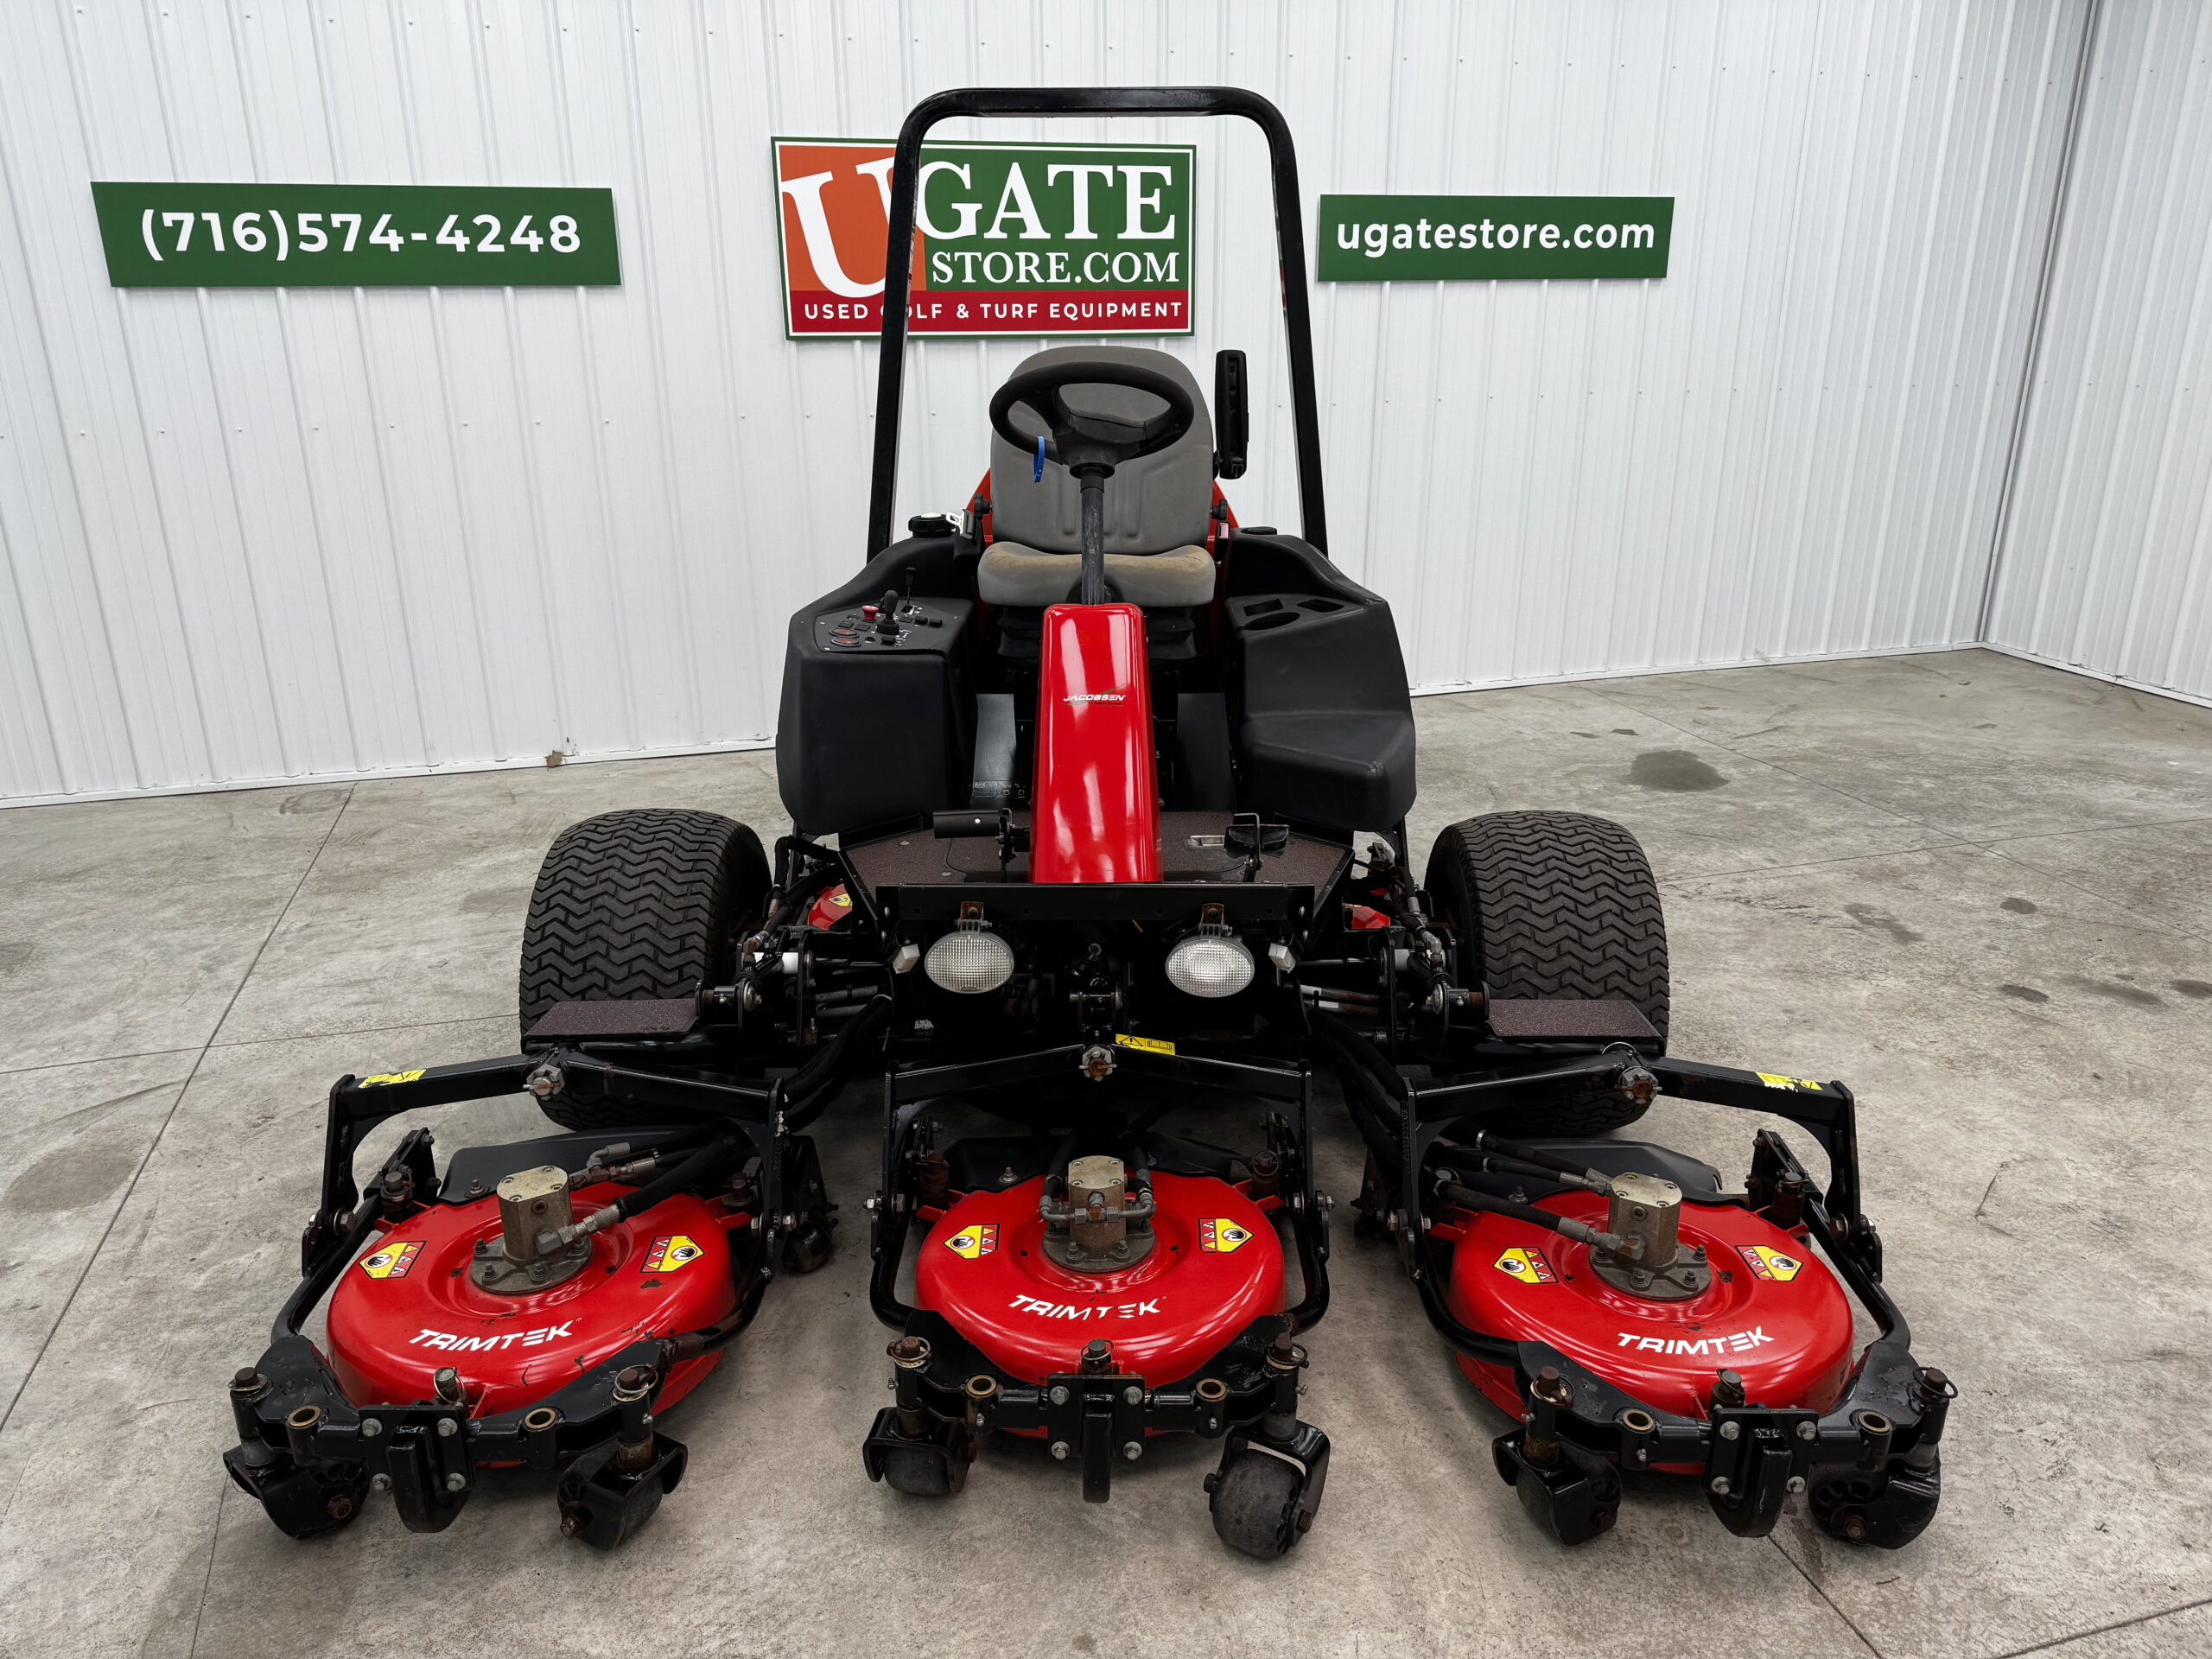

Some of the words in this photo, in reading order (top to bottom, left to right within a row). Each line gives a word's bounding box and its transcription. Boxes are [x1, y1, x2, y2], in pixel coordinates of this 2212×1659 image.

[141, 209, 582, 262] (716)574-4248
[1337, 219, 1656, 258] ugatestore.com
[931, 251, 1180, 283] STORE.COM
[804, 303, 869, 320] USED
[880, 303, 943, 319] LF
[956, 303, 969, 319] &
[979, 303, 1039, 319] TURF
[1049, 302, 1183, 321] EQUIPMENT
[1007, 1294, 1161, 1321] TRIMTEK
[409, 1319, 574, 1351] TRIMTEK
[1617, 1325, 1776, 1356] TRIMTEK
